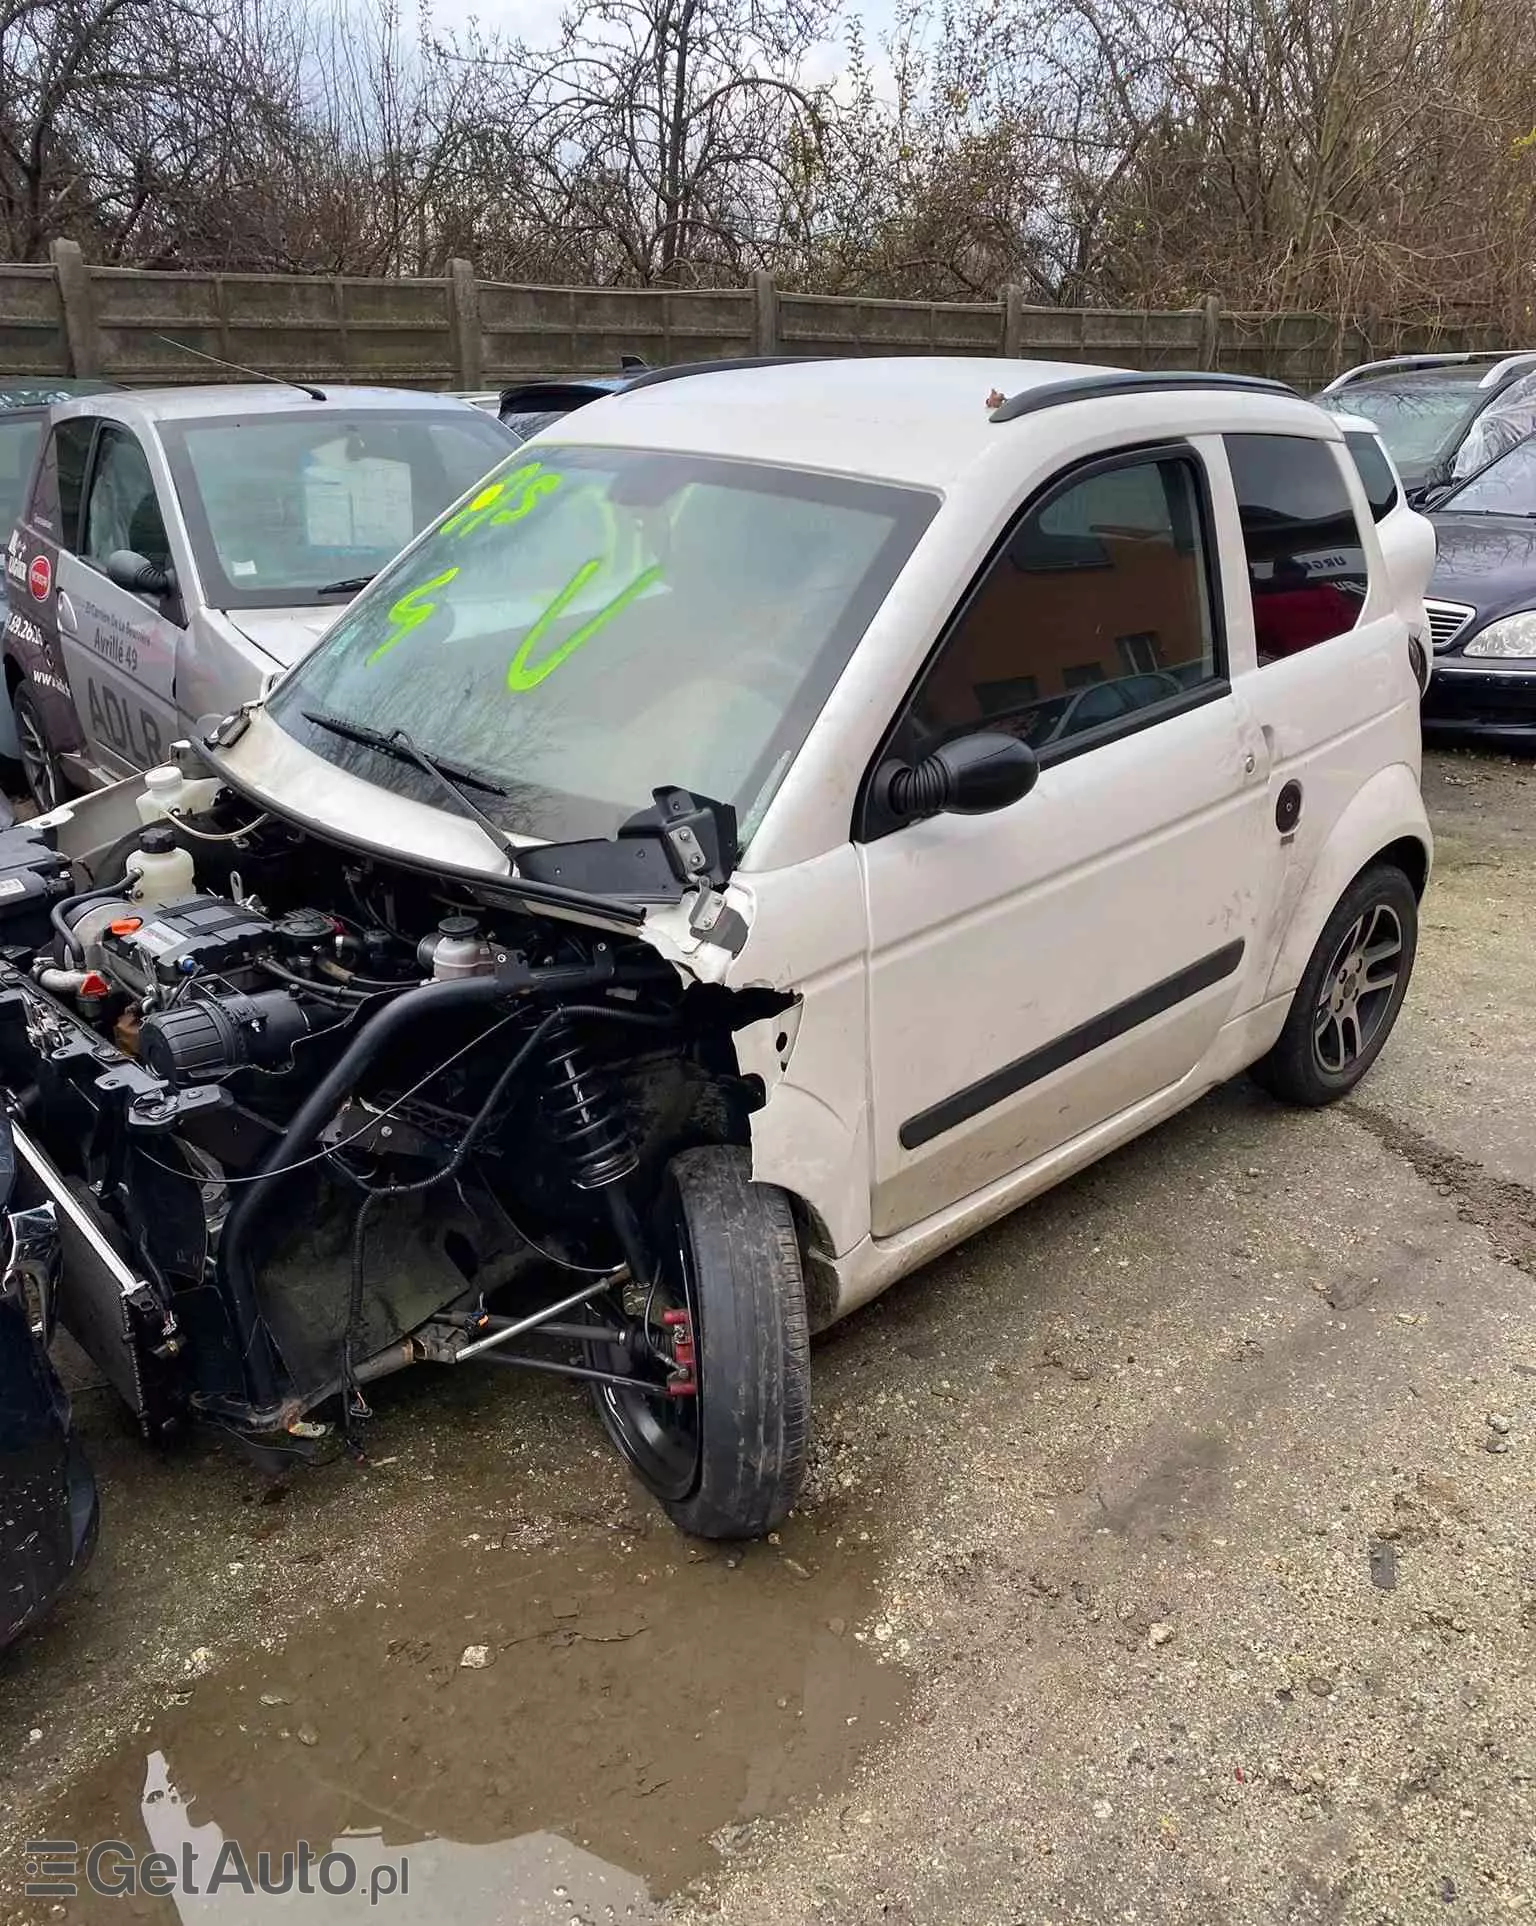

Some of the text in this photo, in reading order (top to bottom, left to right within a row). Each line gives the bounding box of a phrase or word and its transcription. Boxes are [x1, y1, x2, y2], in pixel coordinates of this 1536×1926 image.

[94, 627, 124, 664] Avrillé
[125, 645, 138, 671] 49
[88, 676, 162, 774] ADLR
